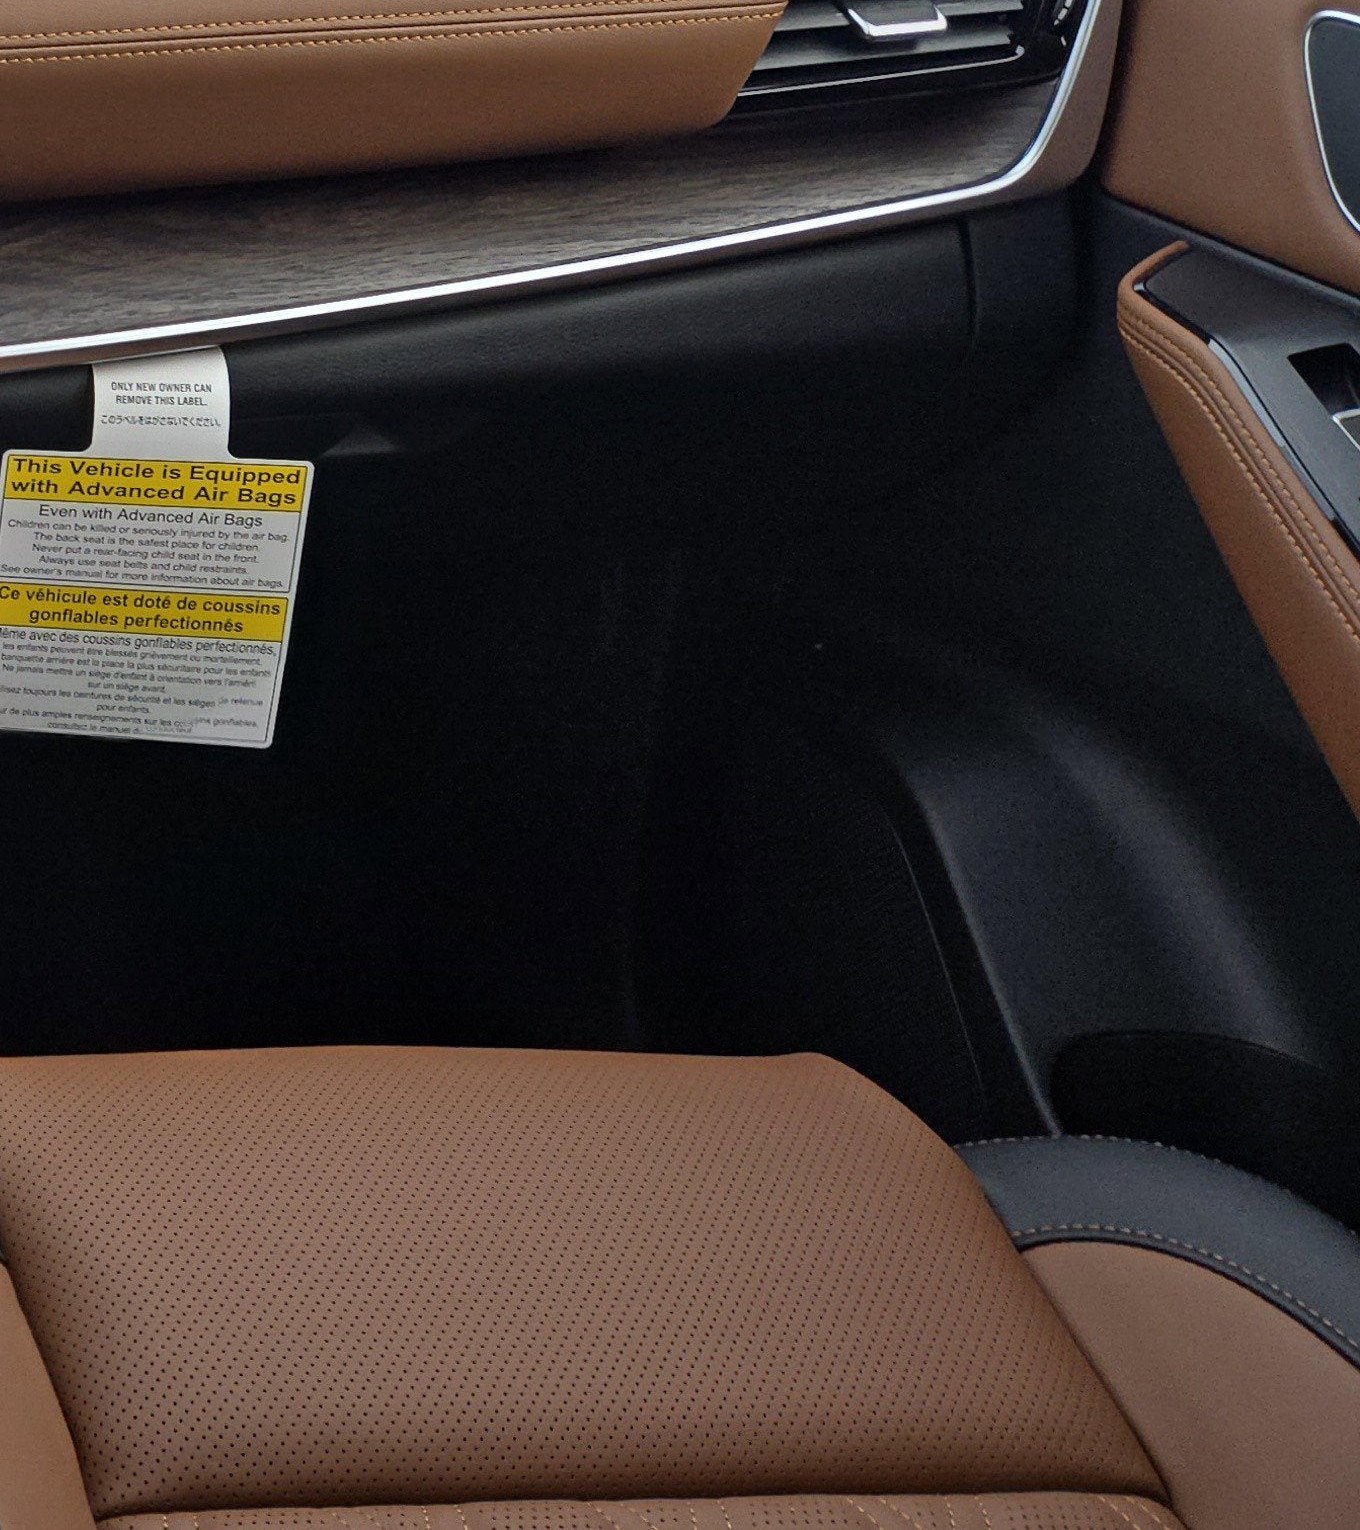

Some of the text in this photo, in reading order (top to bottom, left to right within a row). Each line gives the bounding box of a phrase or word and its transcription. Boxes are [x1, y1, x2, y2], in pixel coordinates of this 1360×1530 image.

[111, 381, 212, 393] ONLY NEW OWNER CAN
[116, 395, 207, 406] REMOVE THIS LABEL.
[11, 458, 300, 485] This Vehicle is Equipped
[10, 478, 297, 506] with Advanced Air Bags
[38, 504, 263, 527] Even with Advanced Air Bags
[25, 587, 97, 604] véhicule
[101, 593, 128, 606] est
[132, 594, 171, 608] doté
[175, 596, 198, 609] de
[202, 596, 281, 614] coussins
[27, 607, 244, 634] gonflables perfectionnés
[26, 632, 58, 640] avec
[57, 631, 81, 642] des
[80, 632, 133, 645] coussins
[132, 635, 194, 651] gonflables
